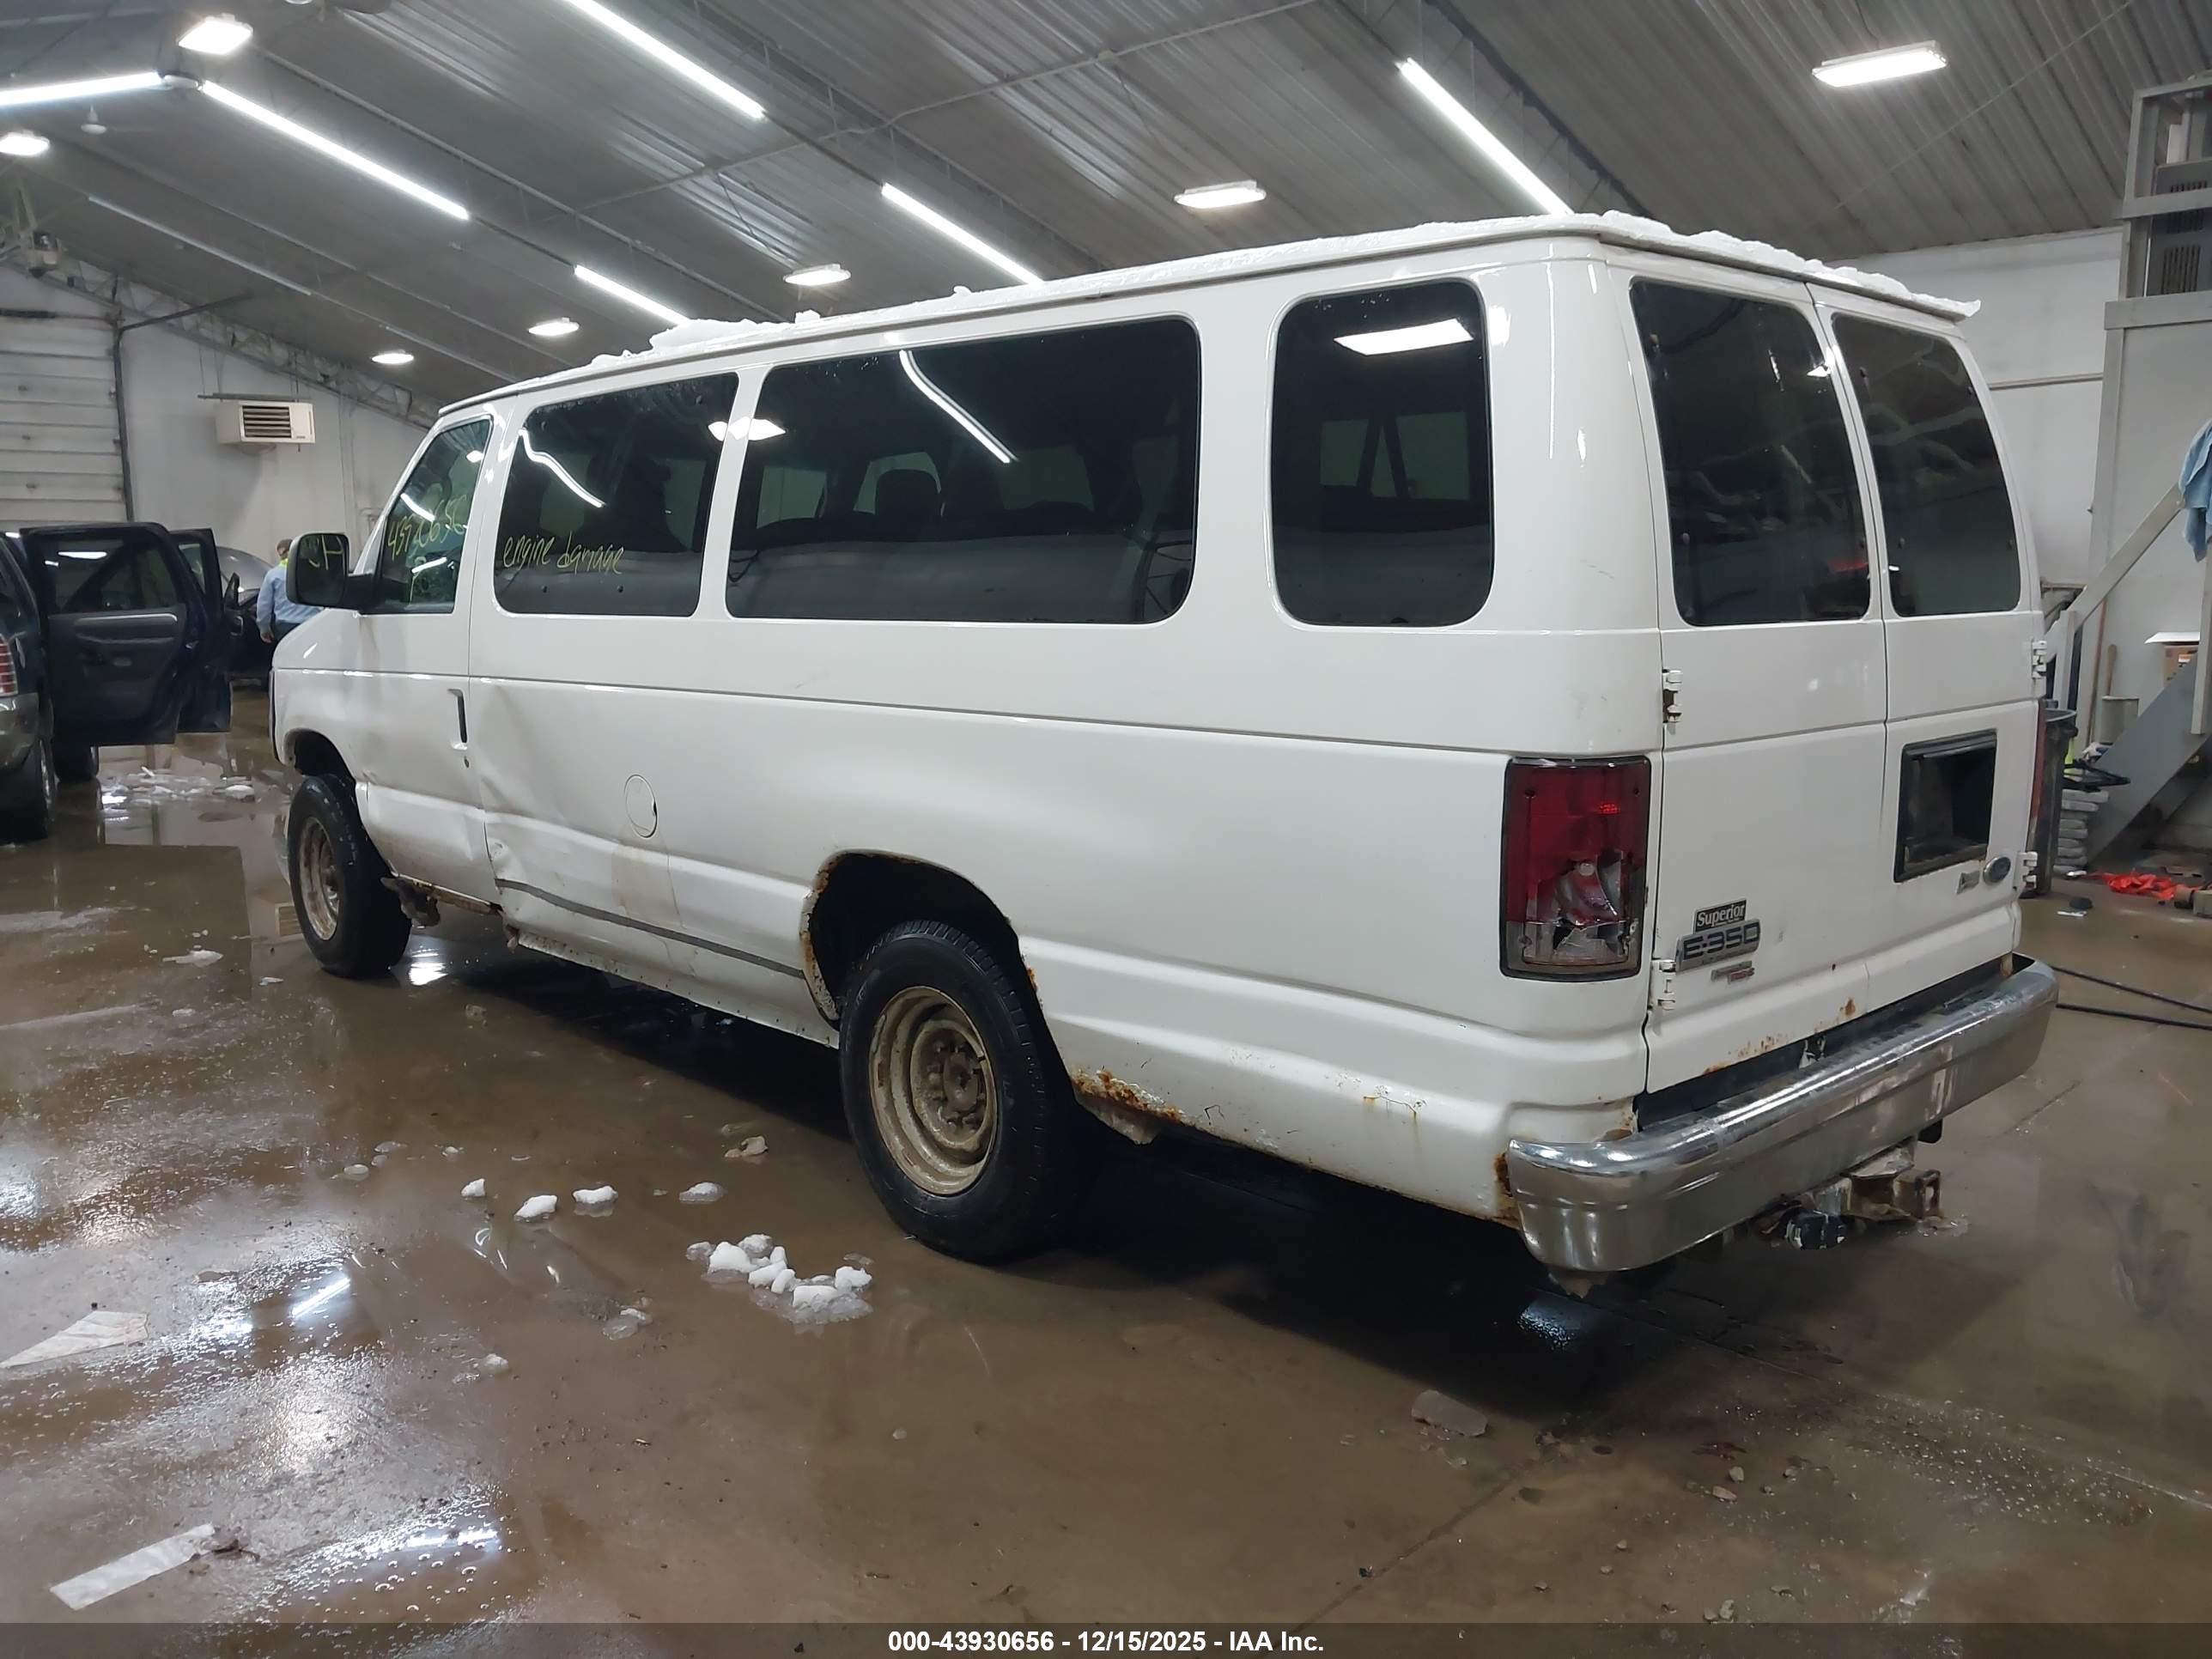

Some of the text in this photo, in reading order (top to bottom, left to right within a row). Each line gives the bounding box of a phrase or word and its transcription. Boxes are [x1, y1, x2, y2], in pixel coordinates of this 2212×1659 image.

[503, 531, 625, 575] engine damage
[1697, 903, 1746, 927] Superior
